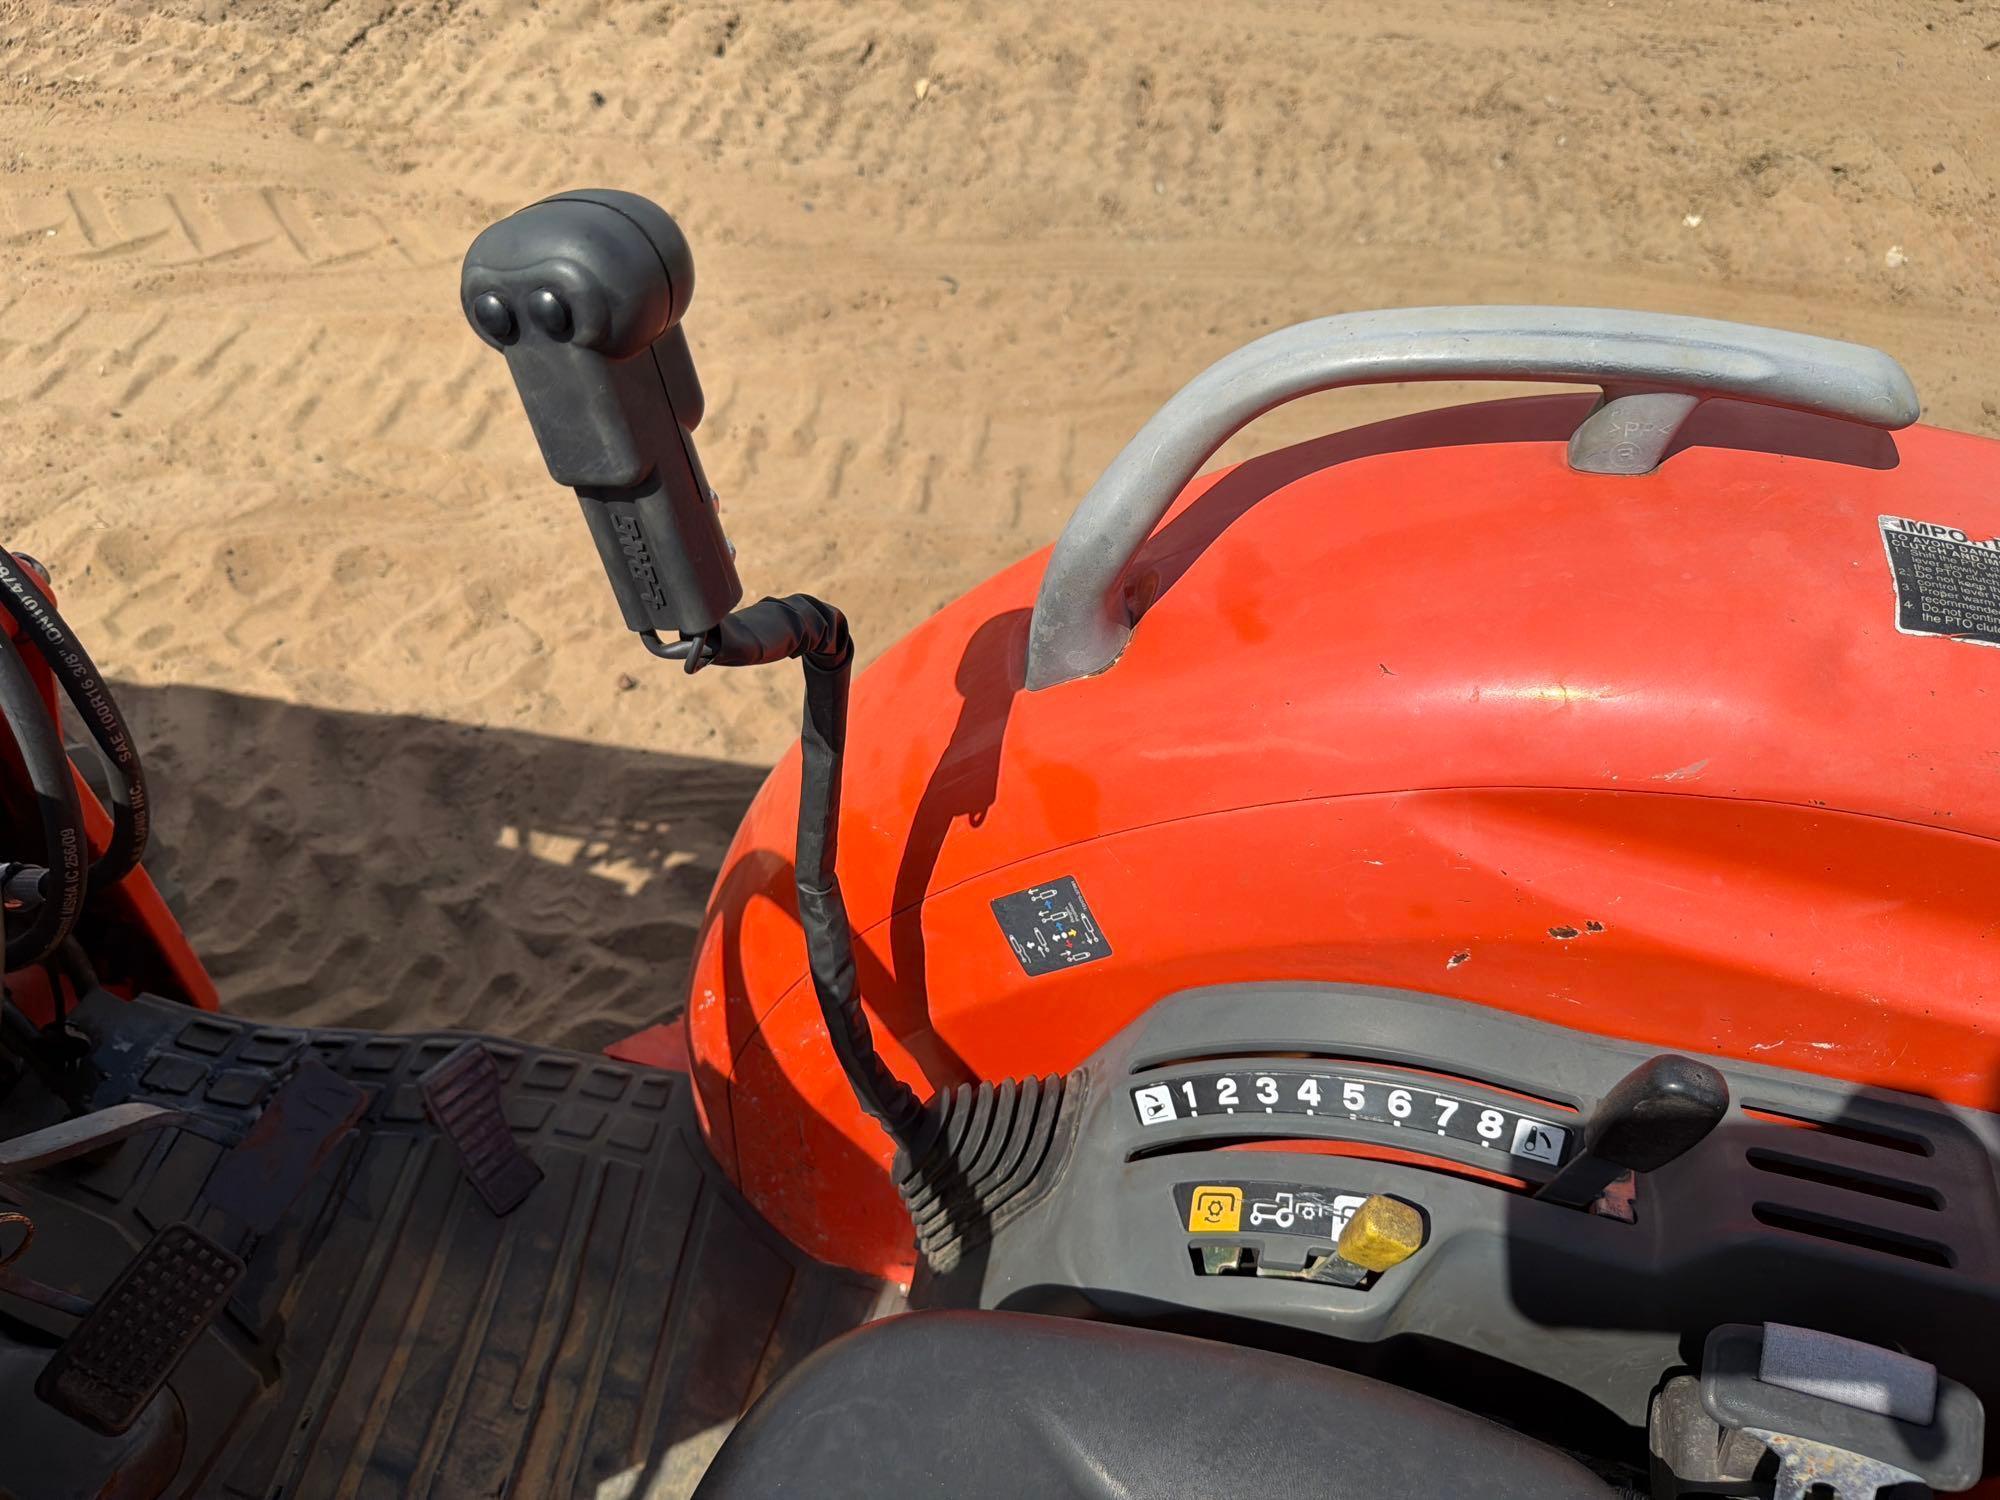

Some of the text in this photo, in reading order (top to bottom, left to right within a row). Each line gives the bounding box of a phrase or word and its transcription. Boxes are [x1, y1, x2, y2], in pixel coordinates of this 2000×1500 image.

[1889, 532, 1908, 541] TO
[1913, 537, 1954, 550] AVOID
[1891, 539, 1947, 555] CLUTCH
[1952, 550, 1980, 562] AND
[1910, 549, 1936, 559] Shift
[1940, 553, 1957, 564] the
[1961, 559, 1987, 570] PTO
[1911, 555, 1940, 568] lever
[0, 562, 22, 593] 478
[1913, 563, 1932, 572] the
[1936, 568, 1962, 578] PTO
[1915, 570, 1933, 579] Do
[1936, 575, 1955, 584] not
[1958, 578, 1986, 592] keep
[1917, 579, 1958, 591] control
[1960, 586, 1990, 598] lever
[1919, 586, 1959, 600] Proper
[1962, 594, 1996, 606] warm
[1921, 595, 2000, 615] recommende
[1921, 602, 1939, 613] Do
[1942, 606, 1962, 617] not
[22, 595, 64, 646] (DN10)
[1922, 612, 1941, 624] the
[1945, 616, 1974, 629] PTO
[81, 678, 120, 733] 100R16
[111, 731, 132, 763] SAE
[59, 828, 79, 868] 256/09
[1181, 1076, 1505, 1139] 1 2 3 4 5 6 7 8
